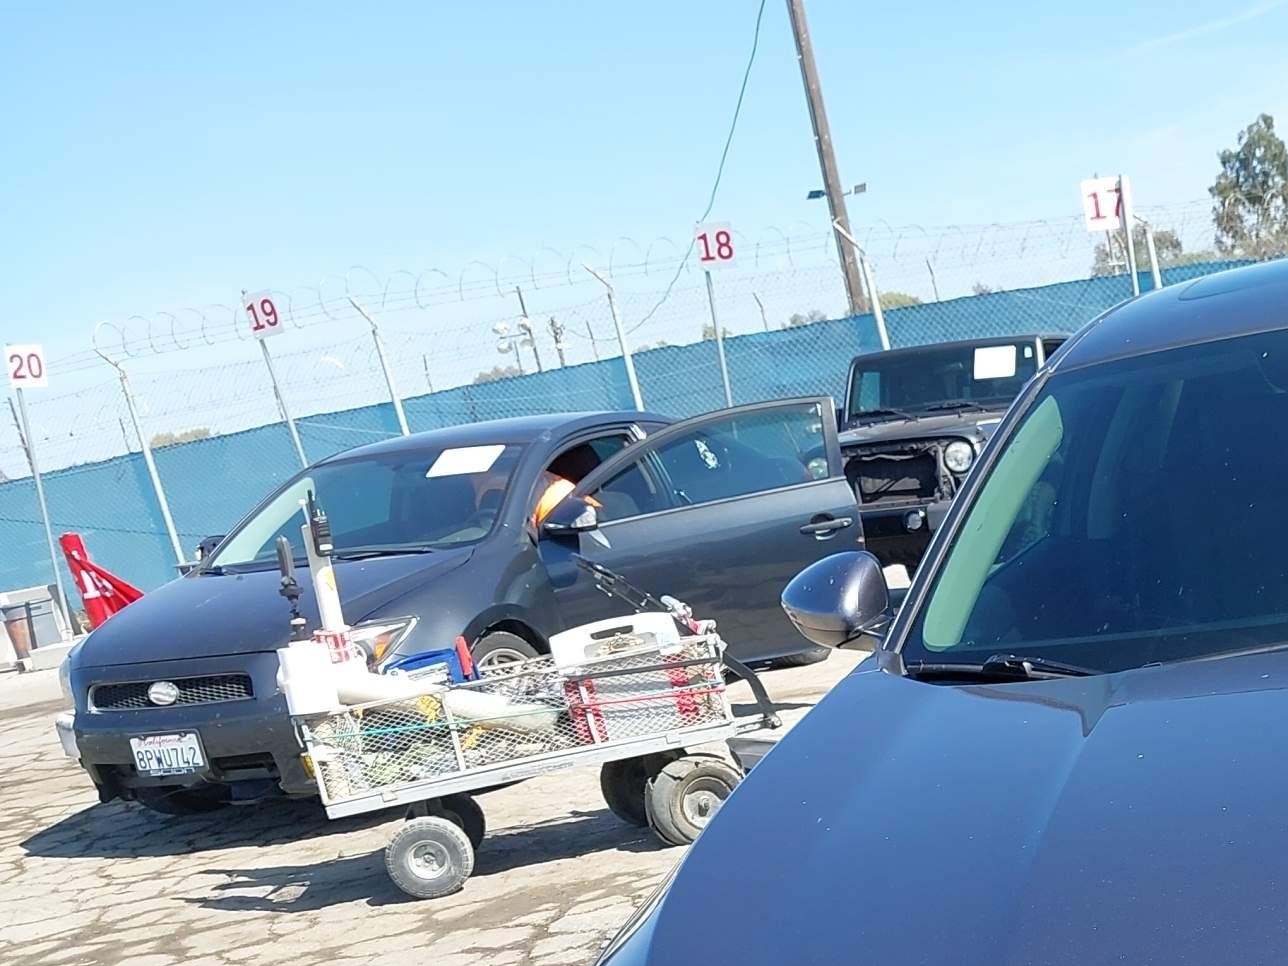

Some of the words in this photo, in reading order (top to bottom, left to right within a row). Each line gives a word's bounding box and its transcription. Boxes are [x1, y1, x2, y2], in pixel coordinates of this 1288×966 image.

[1088, 187, 1122, 220] 17
[697, 230, 734, 261] 18
[246, 298, 278, 332] 19
[9, 353, 43, 379] 20
